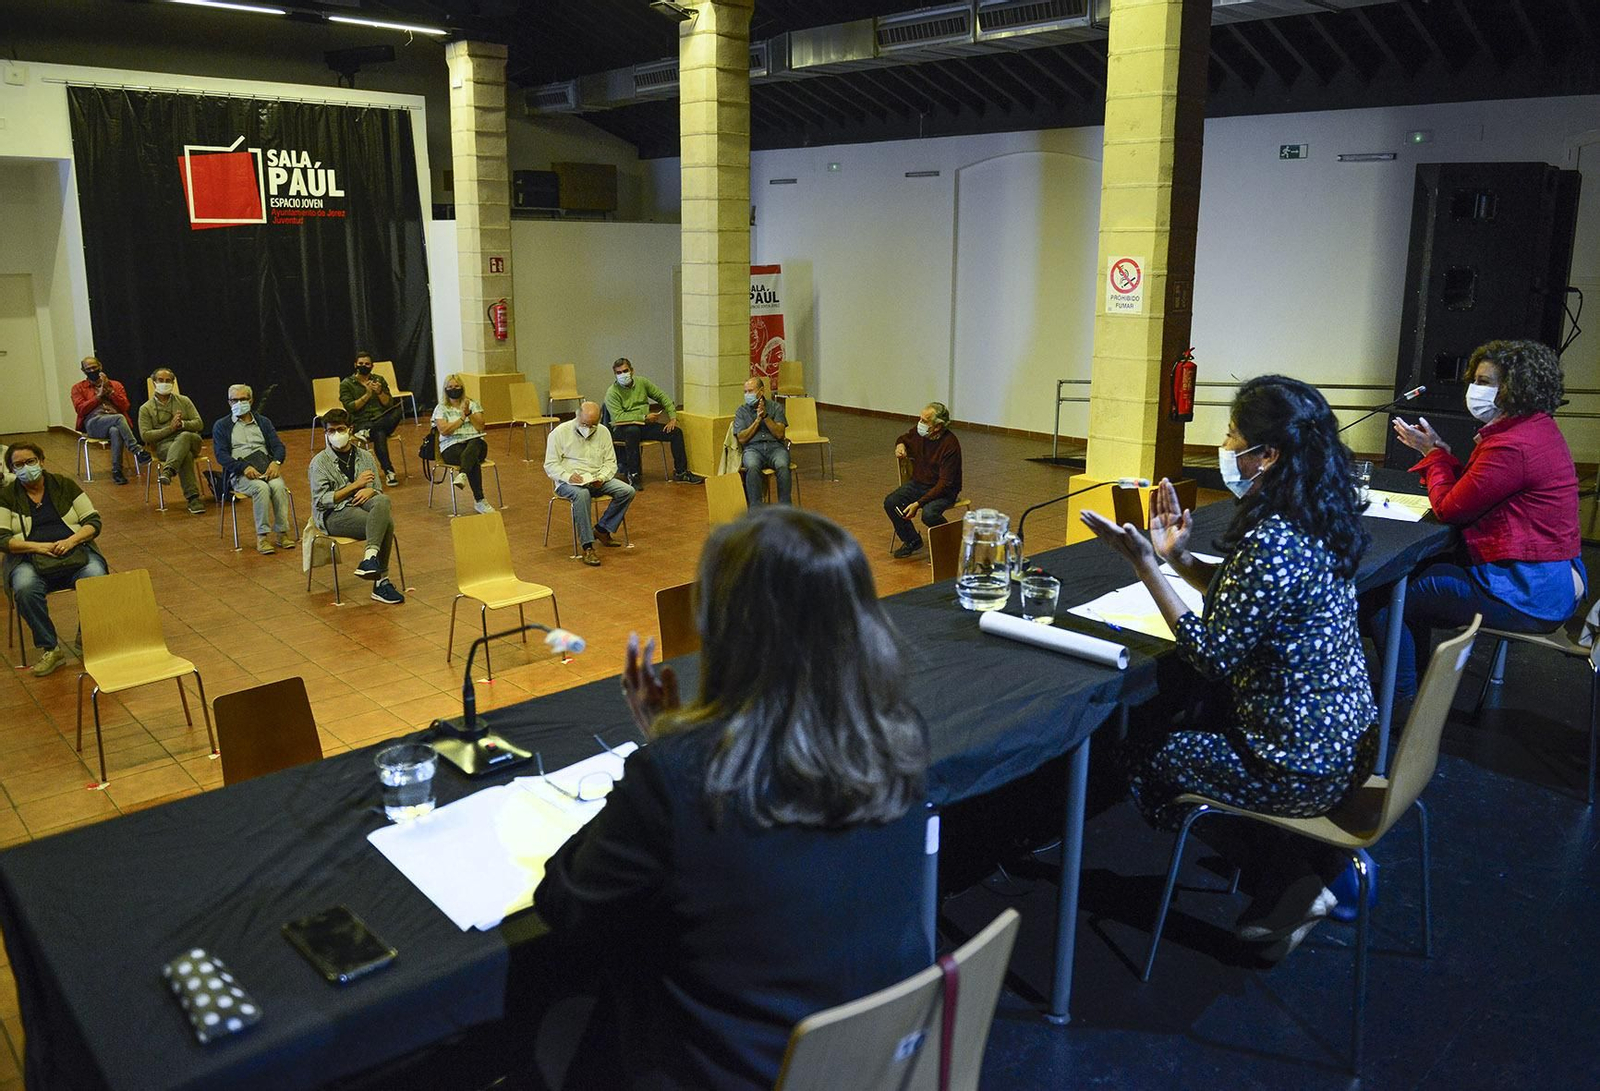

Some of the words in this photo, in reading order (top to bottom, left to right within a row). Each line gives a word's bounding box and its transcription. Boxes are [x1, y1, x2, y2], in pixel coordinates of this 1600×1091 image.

[267, 149, 312, 168] SALA
[268, 161, 345, 197] PAÚL
[270, 197, 301, 208] ESPACIO
[301, 198, 323, 208] JOVEN
[271, 208, 316, 217] Ayuntamiento
[317, 209, 326, 217] de
[327, 209, 346, 218] Jerez
[272, 216, 304, 224] Juventud
[751, 284, 766, 292] ALA
